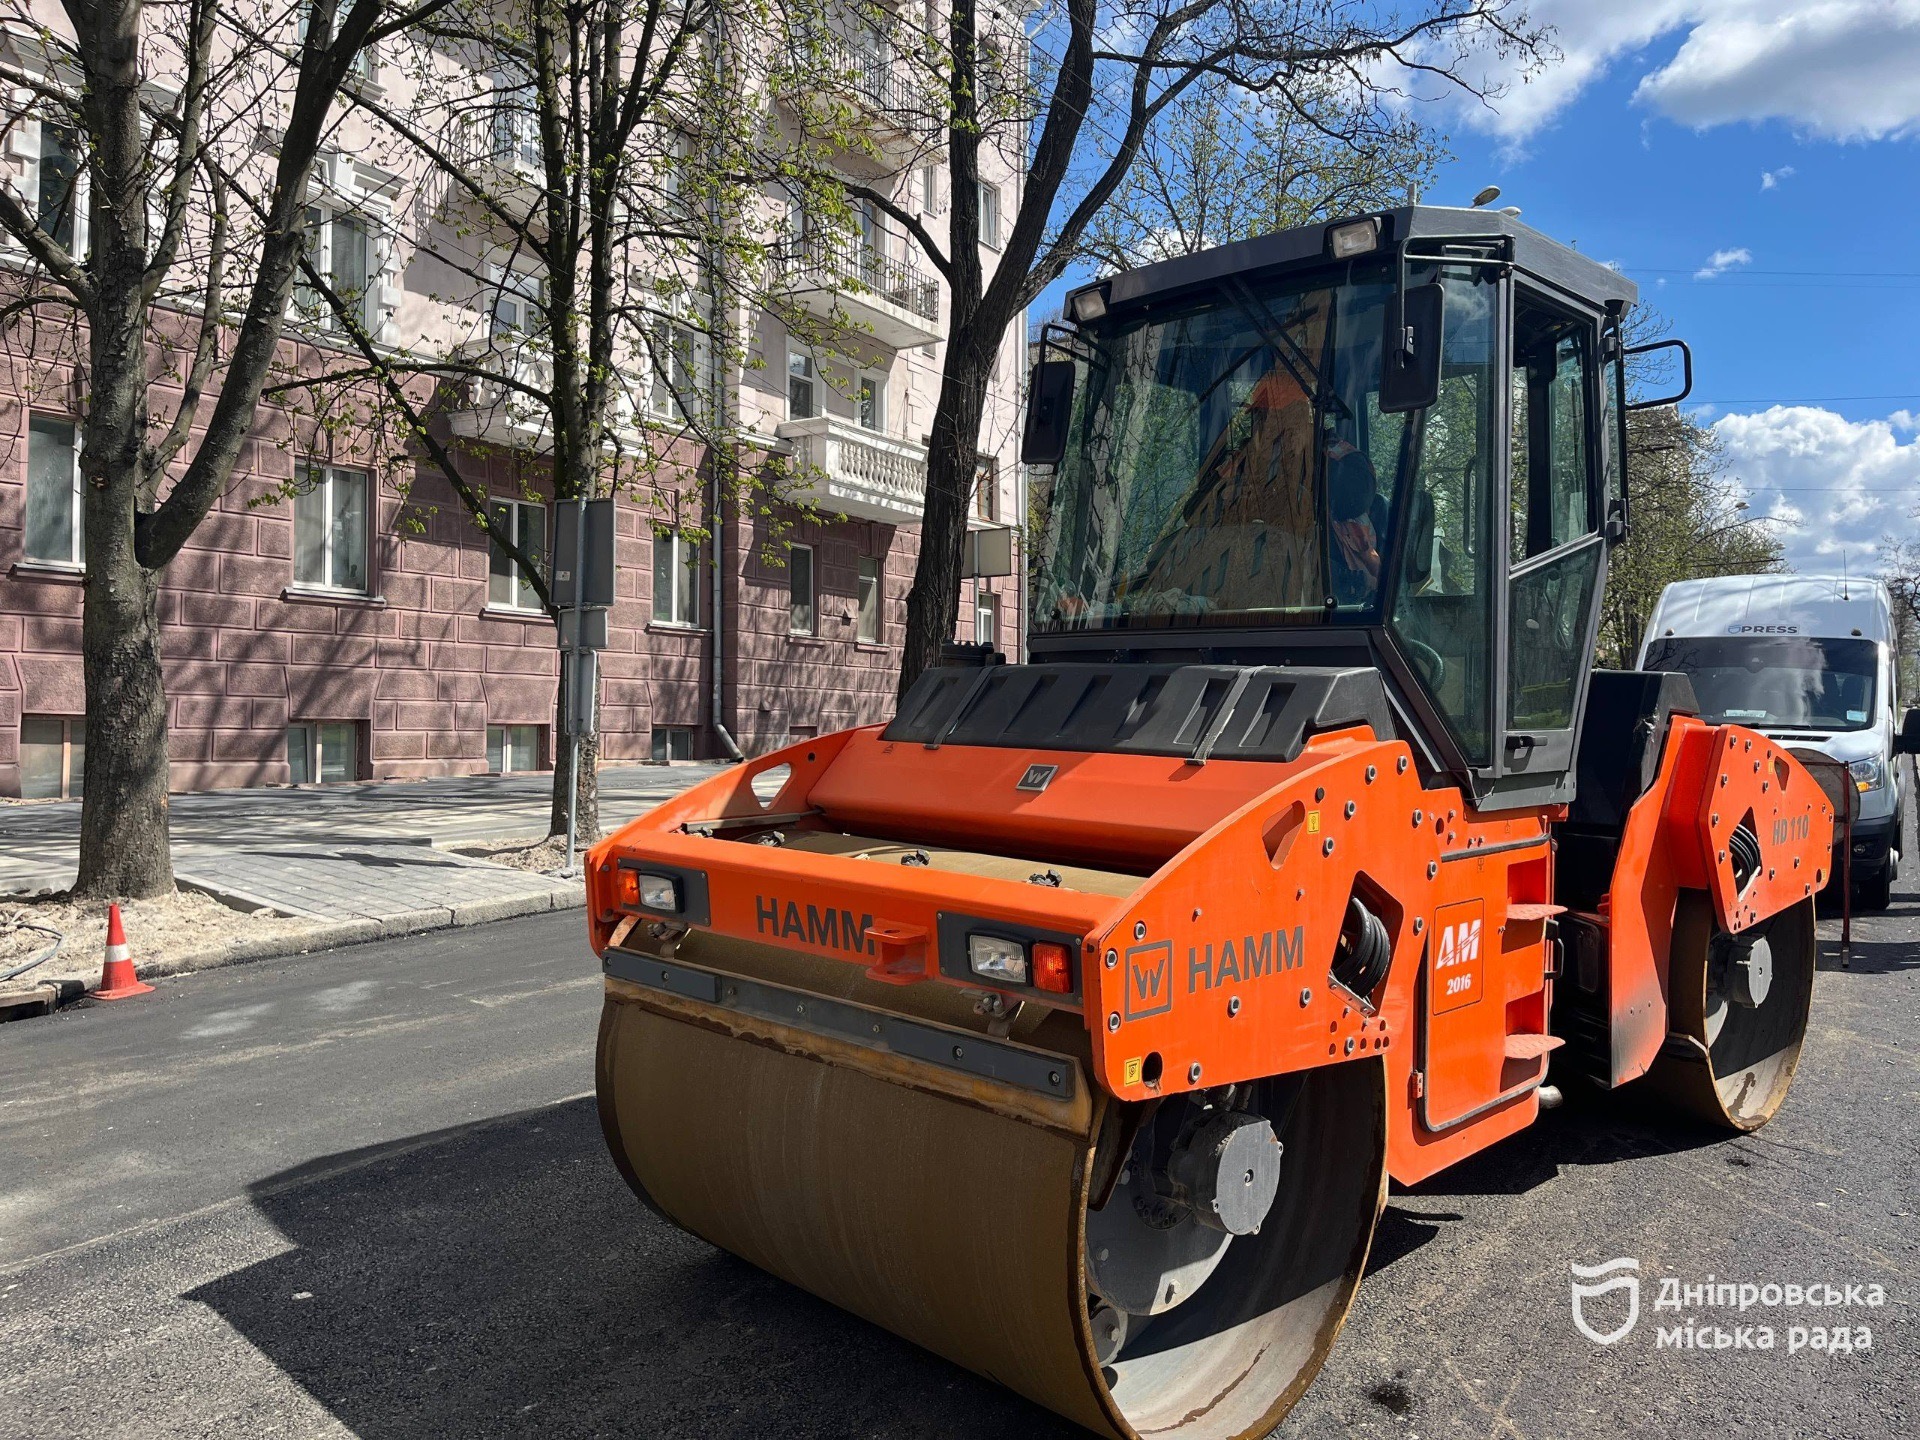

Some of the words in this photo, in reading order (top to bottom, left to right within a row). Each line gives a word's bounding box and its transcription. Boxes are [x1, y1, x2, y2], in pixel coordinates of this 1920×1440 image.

[1741, 625, 1798, 634] PRESS
[1771, 818, 1788, 847] HD
[1790, 814, 1809, 841] 110
[755, 894, 876, 956] HAMM
[1435, 918, 1482, 970] AM
[1132, 958, 1166, 1000] W
[1188, 925, 1304, 994] HAMM
[1446, 973, 1472, 996] 2016
